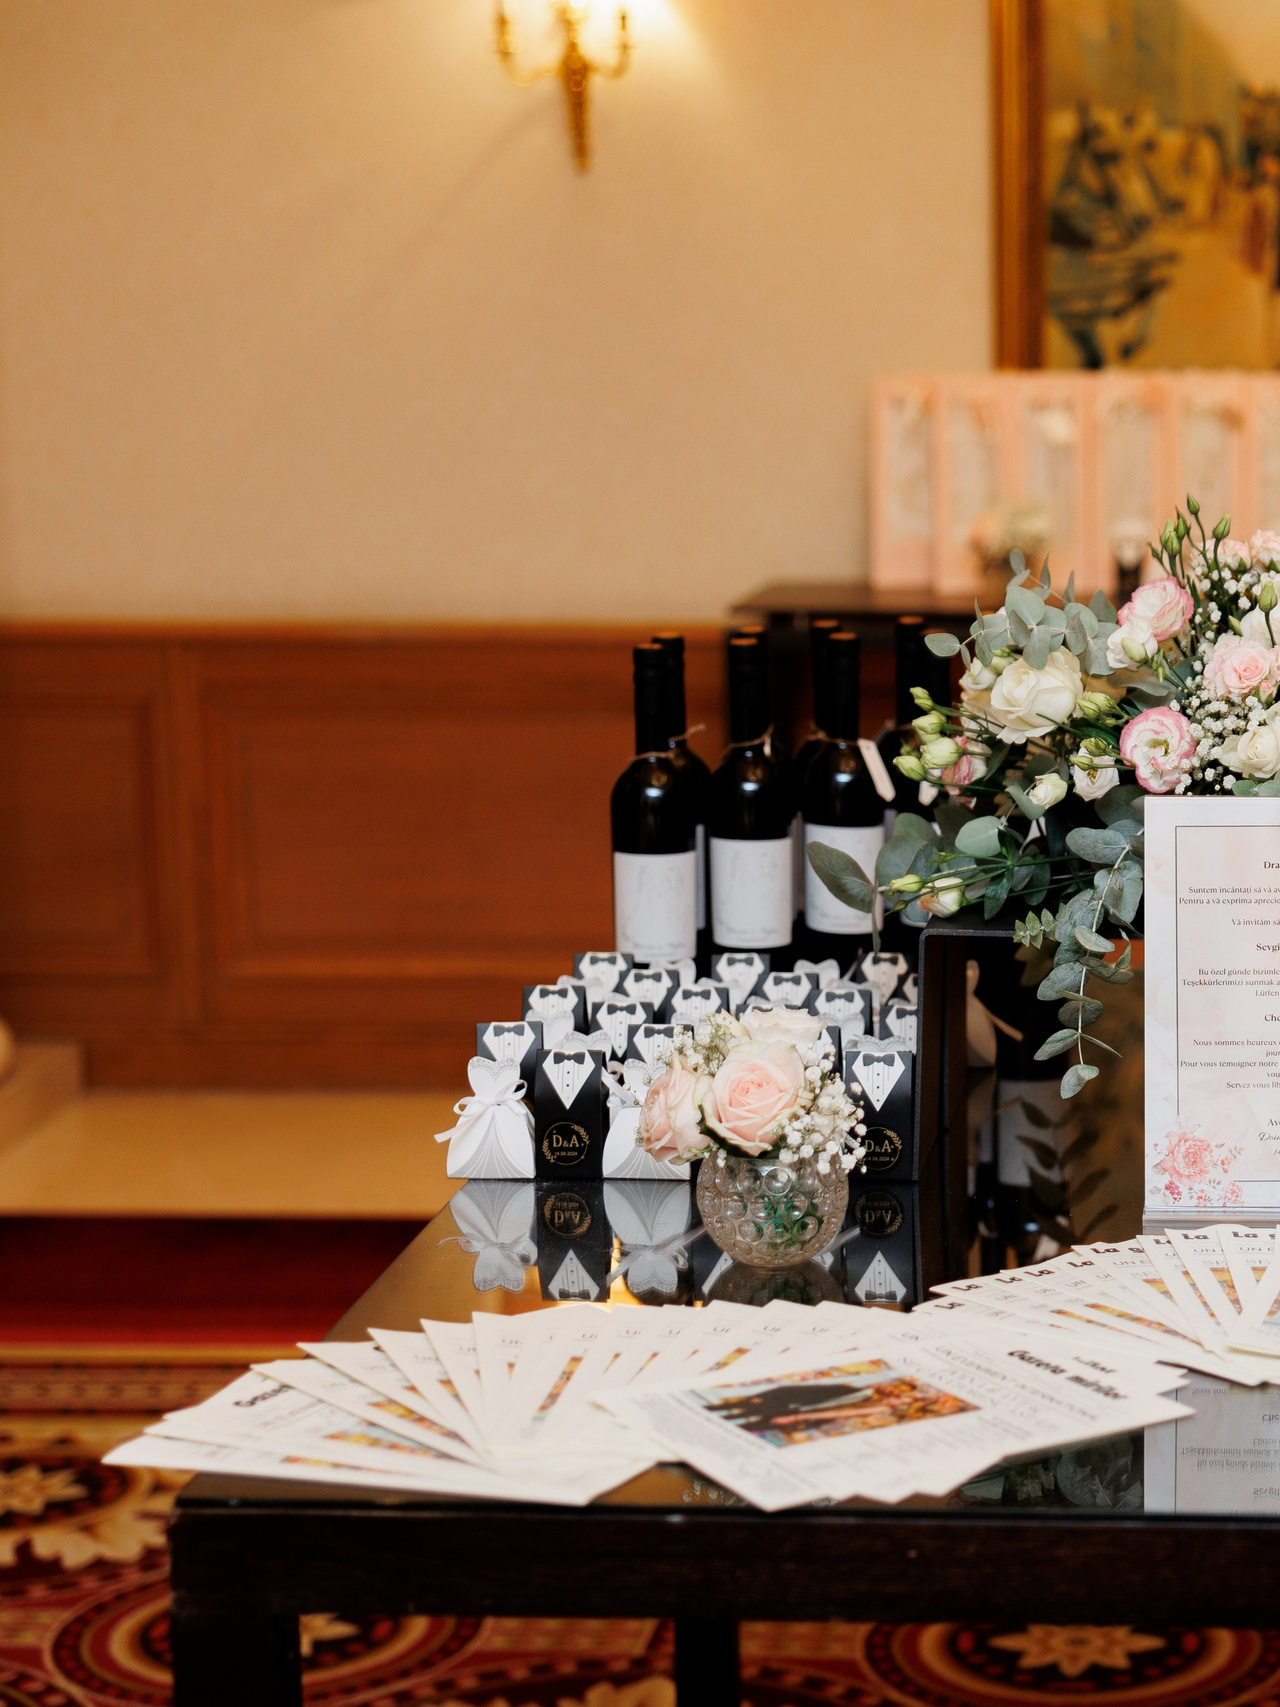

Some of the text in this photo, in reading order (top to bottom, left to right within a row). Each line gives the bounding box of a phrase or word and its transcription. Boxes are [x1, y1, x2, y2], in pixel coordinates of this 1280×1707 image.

[1188, 886, 1219, 894] Suntem
[1179, 897, 1205, 905] Pentru
[1221, 897, 1253, 906] exprima
[1198, 968, 1209, 976] Bu
[1210, 968, 1226, 976] özel
[1227, 968, 1252, 977] günde
[1180, 1060, 1198, 1068] Pour
[1219, 1060, 1257, 1069] témoigner
[1226, 1081, 1251, 1089] Servez
[552, 1134, 580, 1148] D&A
[864, 1139, 892, 1153] D&A
[1182, 1232, 1210, 1241] La
[1232, 1231, 1259, 1239] La
[1091, 1247, 1120, 1255] La
[1067, 1260, 1095, 1269] La
[1024, 1268, 1056, 1278] La
[951, 1282, 982, 1292] La
